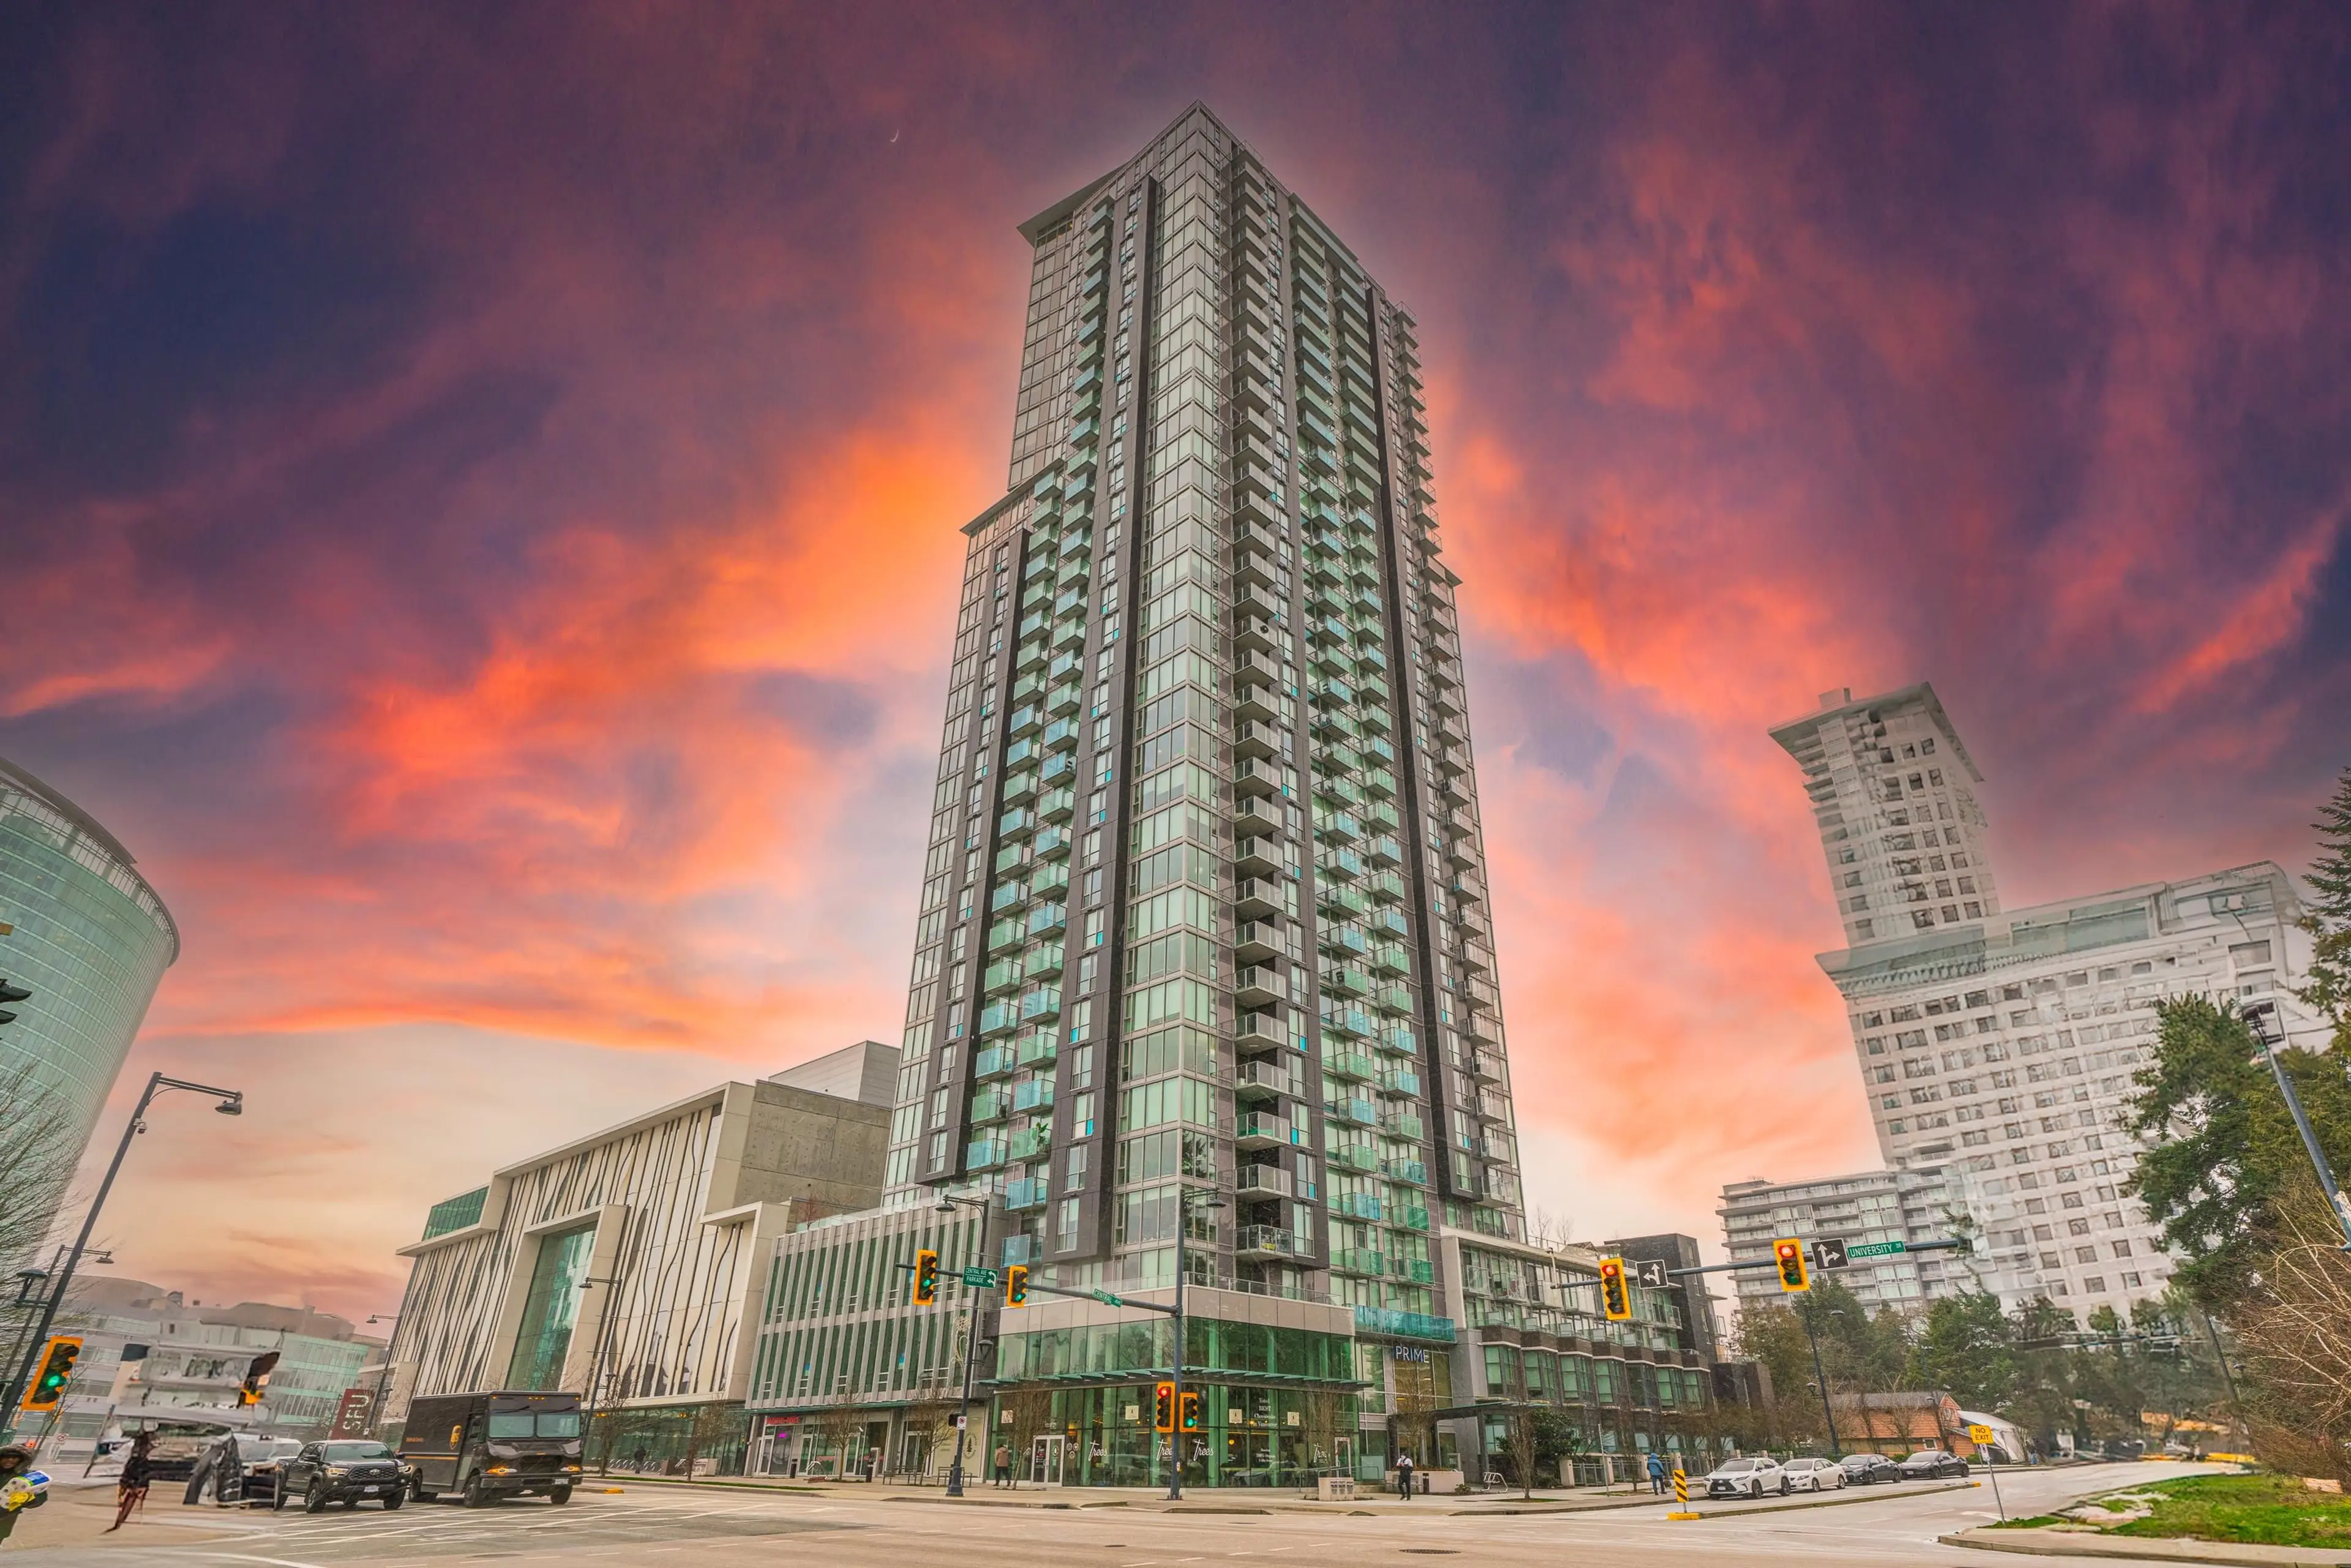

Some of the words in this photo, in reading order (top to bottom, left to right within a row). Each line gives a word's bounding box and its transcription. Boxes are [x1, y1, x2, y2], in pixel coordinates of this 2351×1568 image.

[1850, 1244, 1892, 1257] UNIVERSITY
[1093, 1289, 1112, 1304] CENTRAL
[1396, 1346, 1430, 1364] PRIME
[343, 1395, 369, 1430] SFU
[1088, 1440, 1108, 1461] Trees
[1156, 1439, 1172, 1461] Tree
[1193, 1439, 1214, 1461] Trees
